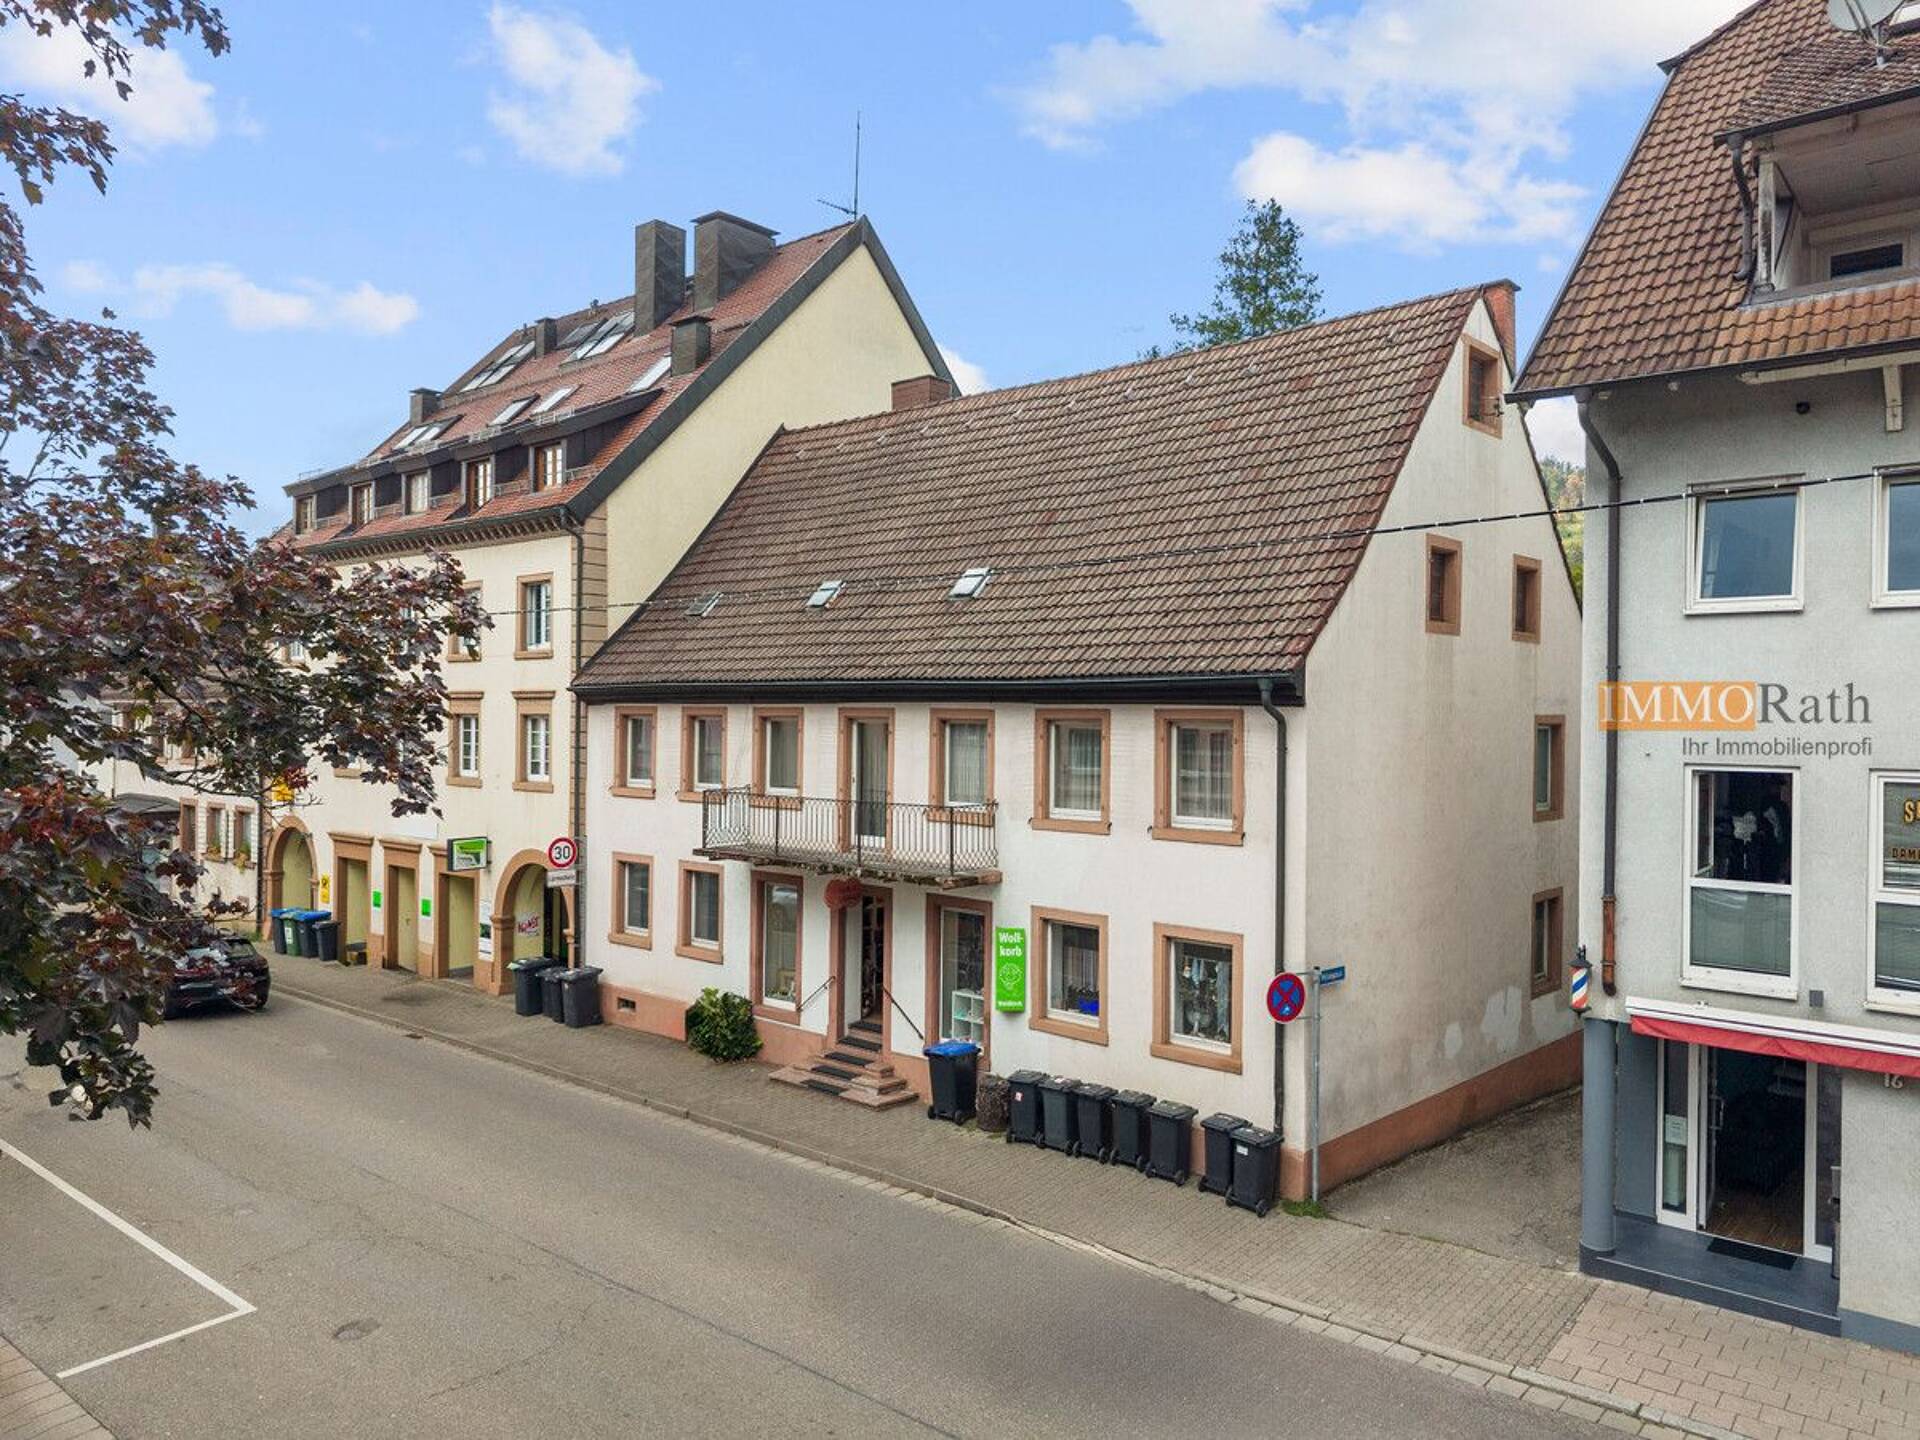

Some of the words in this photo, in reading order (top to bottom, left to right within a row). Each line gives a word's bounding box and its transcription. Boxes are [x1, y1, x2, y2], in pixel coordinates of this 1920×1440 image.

[554, 845, 570, 860] 30
[1892, 847, 1920, 860] DAM
[999, 932, 1024, 944] Woll-
[999, 945, 1022, 957] korb
[1884, 1072, 1904, 1089] 16
